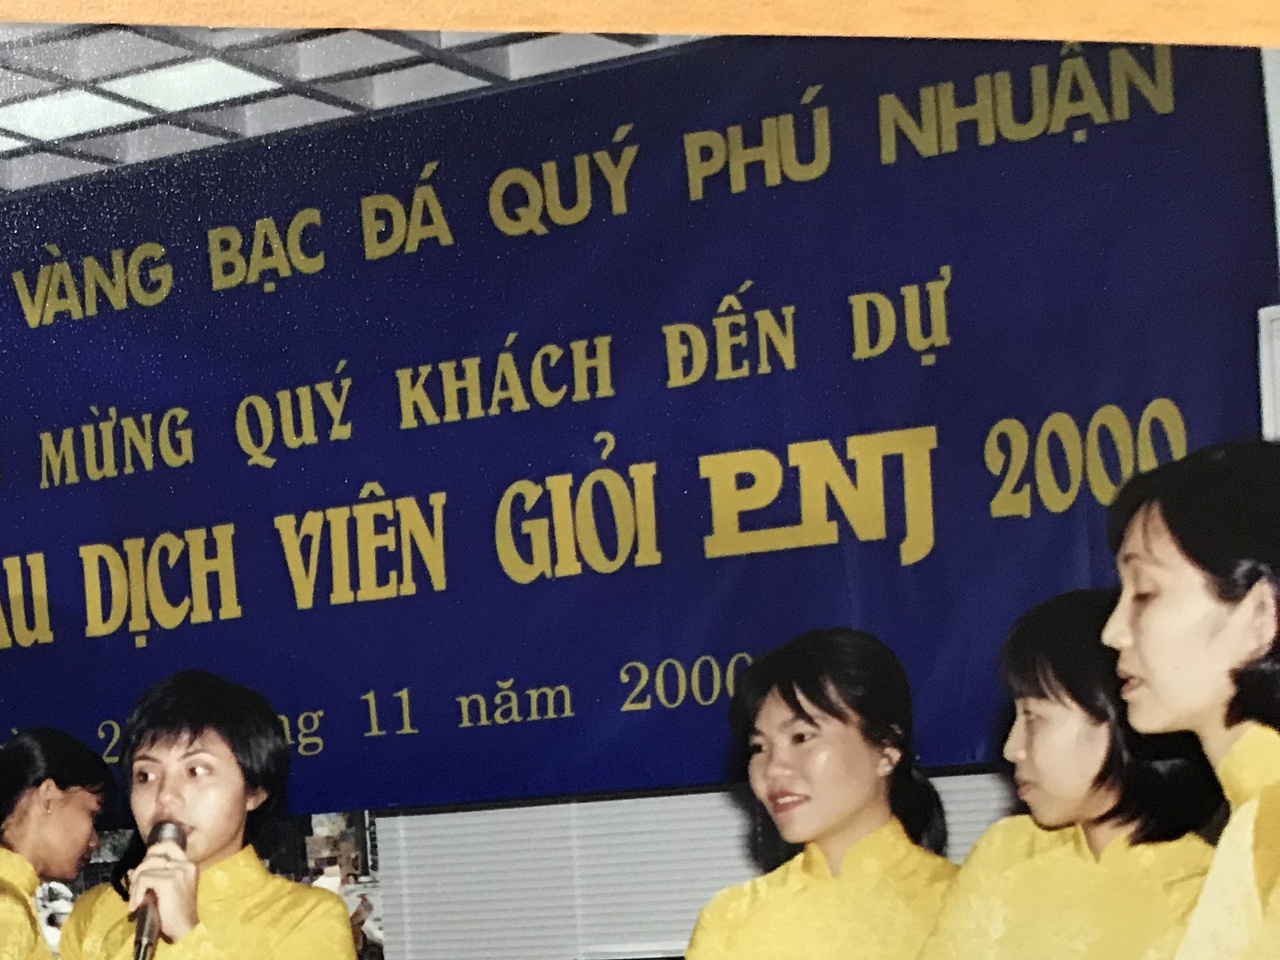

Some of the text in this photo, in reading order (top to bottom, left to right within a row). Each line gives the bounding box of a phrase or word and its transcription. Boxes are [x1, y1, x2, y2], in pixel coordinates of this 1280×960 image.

[11, 243, 174, 328] VÀNG
[207, 208, 326, 293] BẠC
[360, 161, 453, 260] ĐÁ
[488, 124, 638, 236] QUÝ
[683, 85, 832, 201] PHÚ
[878, 41, 1175, 165] NHUẬN
[40, 406, 194, 488] MỪNG
[235, 359, 353, 468] QUÝ
[395, 333, 615, 430] KHÁCH
[662, 280, 796, 388] ĐẾN
[849, 266, 953, 366] DỰ
[78, 523, 242, 648] DỊCH
[273, 481, 447, 610] VIÊN
[495, 431, 662, 584] GIỎI
[698, 425, 939, 566] PNJ
[984, 397, 1188, 519] 2000
[360, 687, 418, 738] 11
[456, 677, 575, 727] năm
